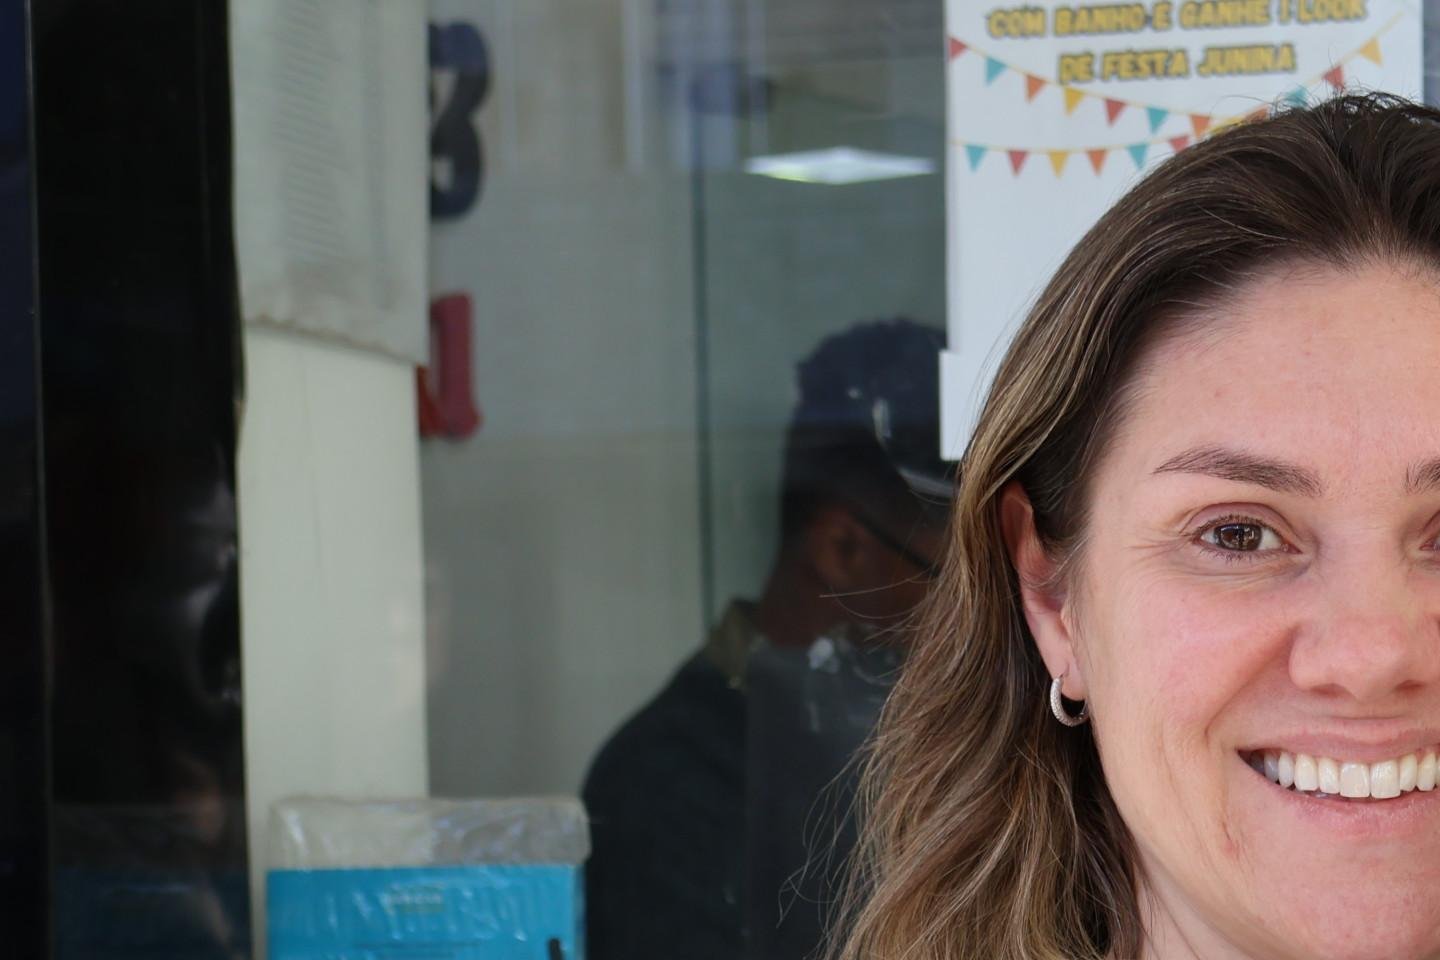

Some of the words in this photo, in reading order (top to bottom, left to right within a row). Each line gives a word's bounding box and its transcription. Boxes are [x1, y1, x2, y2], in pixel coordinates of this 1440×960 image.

[988, 7, 1046, 38] COM
[1054, 4, 1146, 36] BANHO
[1151, 1, 1173, 31] E
[1179, 0, 1271, 29] GANHE
[1296, 0, 1367, 24] LOOK
[1059, 52, 1095, 83] DE
[1102, 49, 1190, 82] FESTA
[1197, 43, 1296, 76] JUNINA
